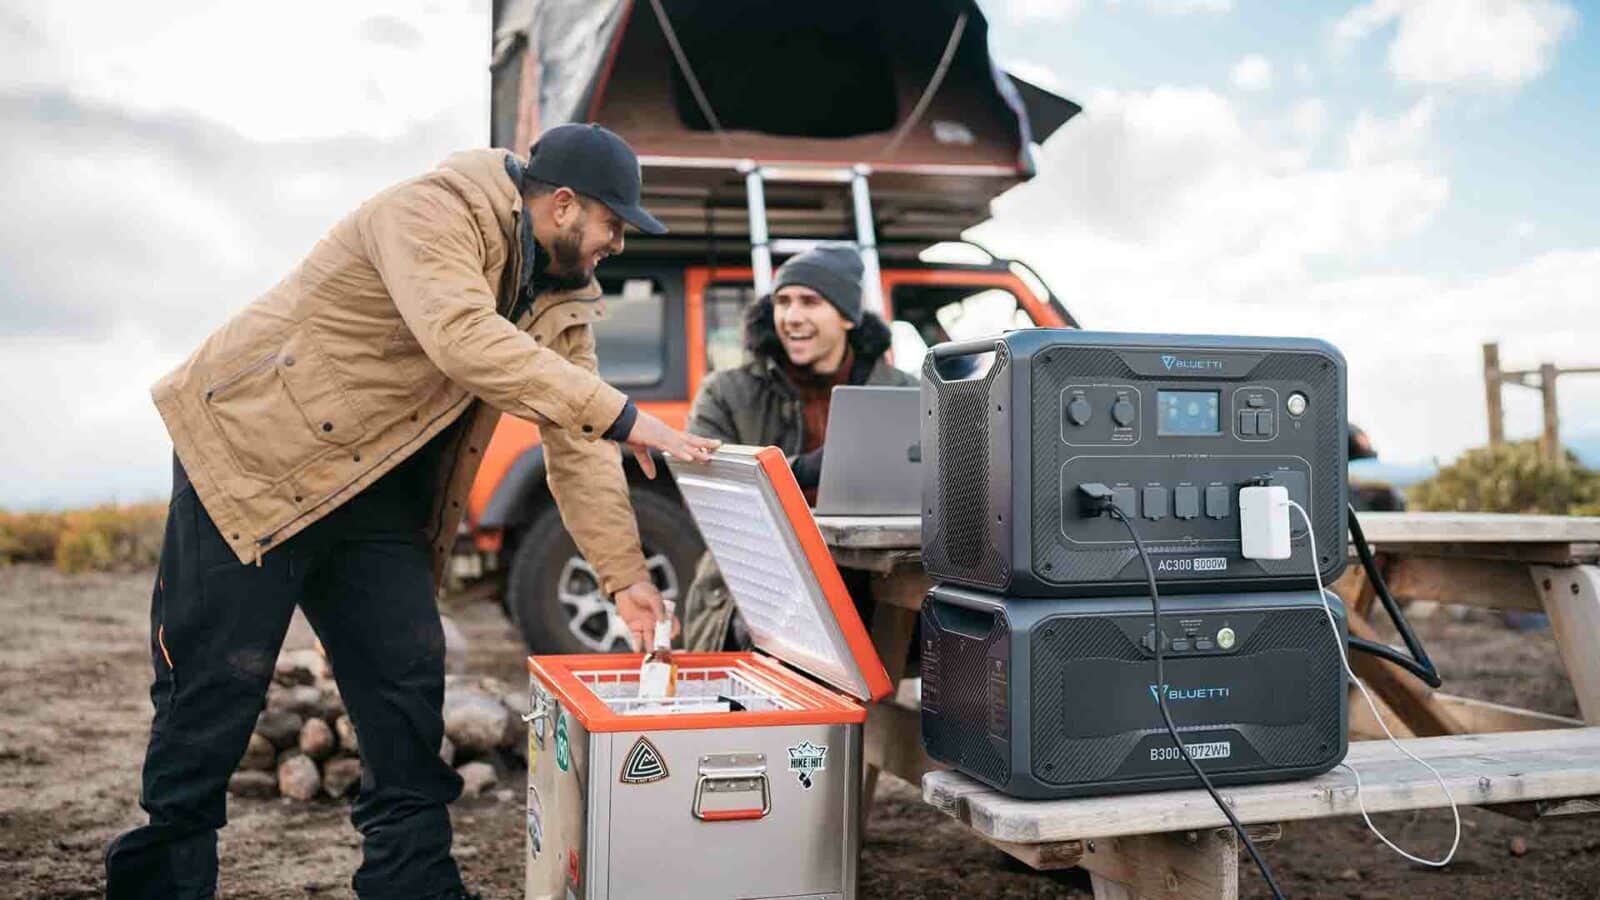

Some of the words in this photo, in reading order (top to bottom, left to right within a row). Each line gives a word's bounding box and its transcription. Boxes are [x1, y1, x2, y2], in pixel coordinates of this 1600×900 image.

[1176, 359, 1223, 369] BLUETTI
[1158, 559, 1192, 571] AC300
[1194, 558, 1226, 570] 3000W
[1169, 687, 1230, 700] BLUETTI
[1150, 747, 1180, 761] B300
[790, 756, 807, 768] HIKE
[811, 757, 822, 768] HIT
